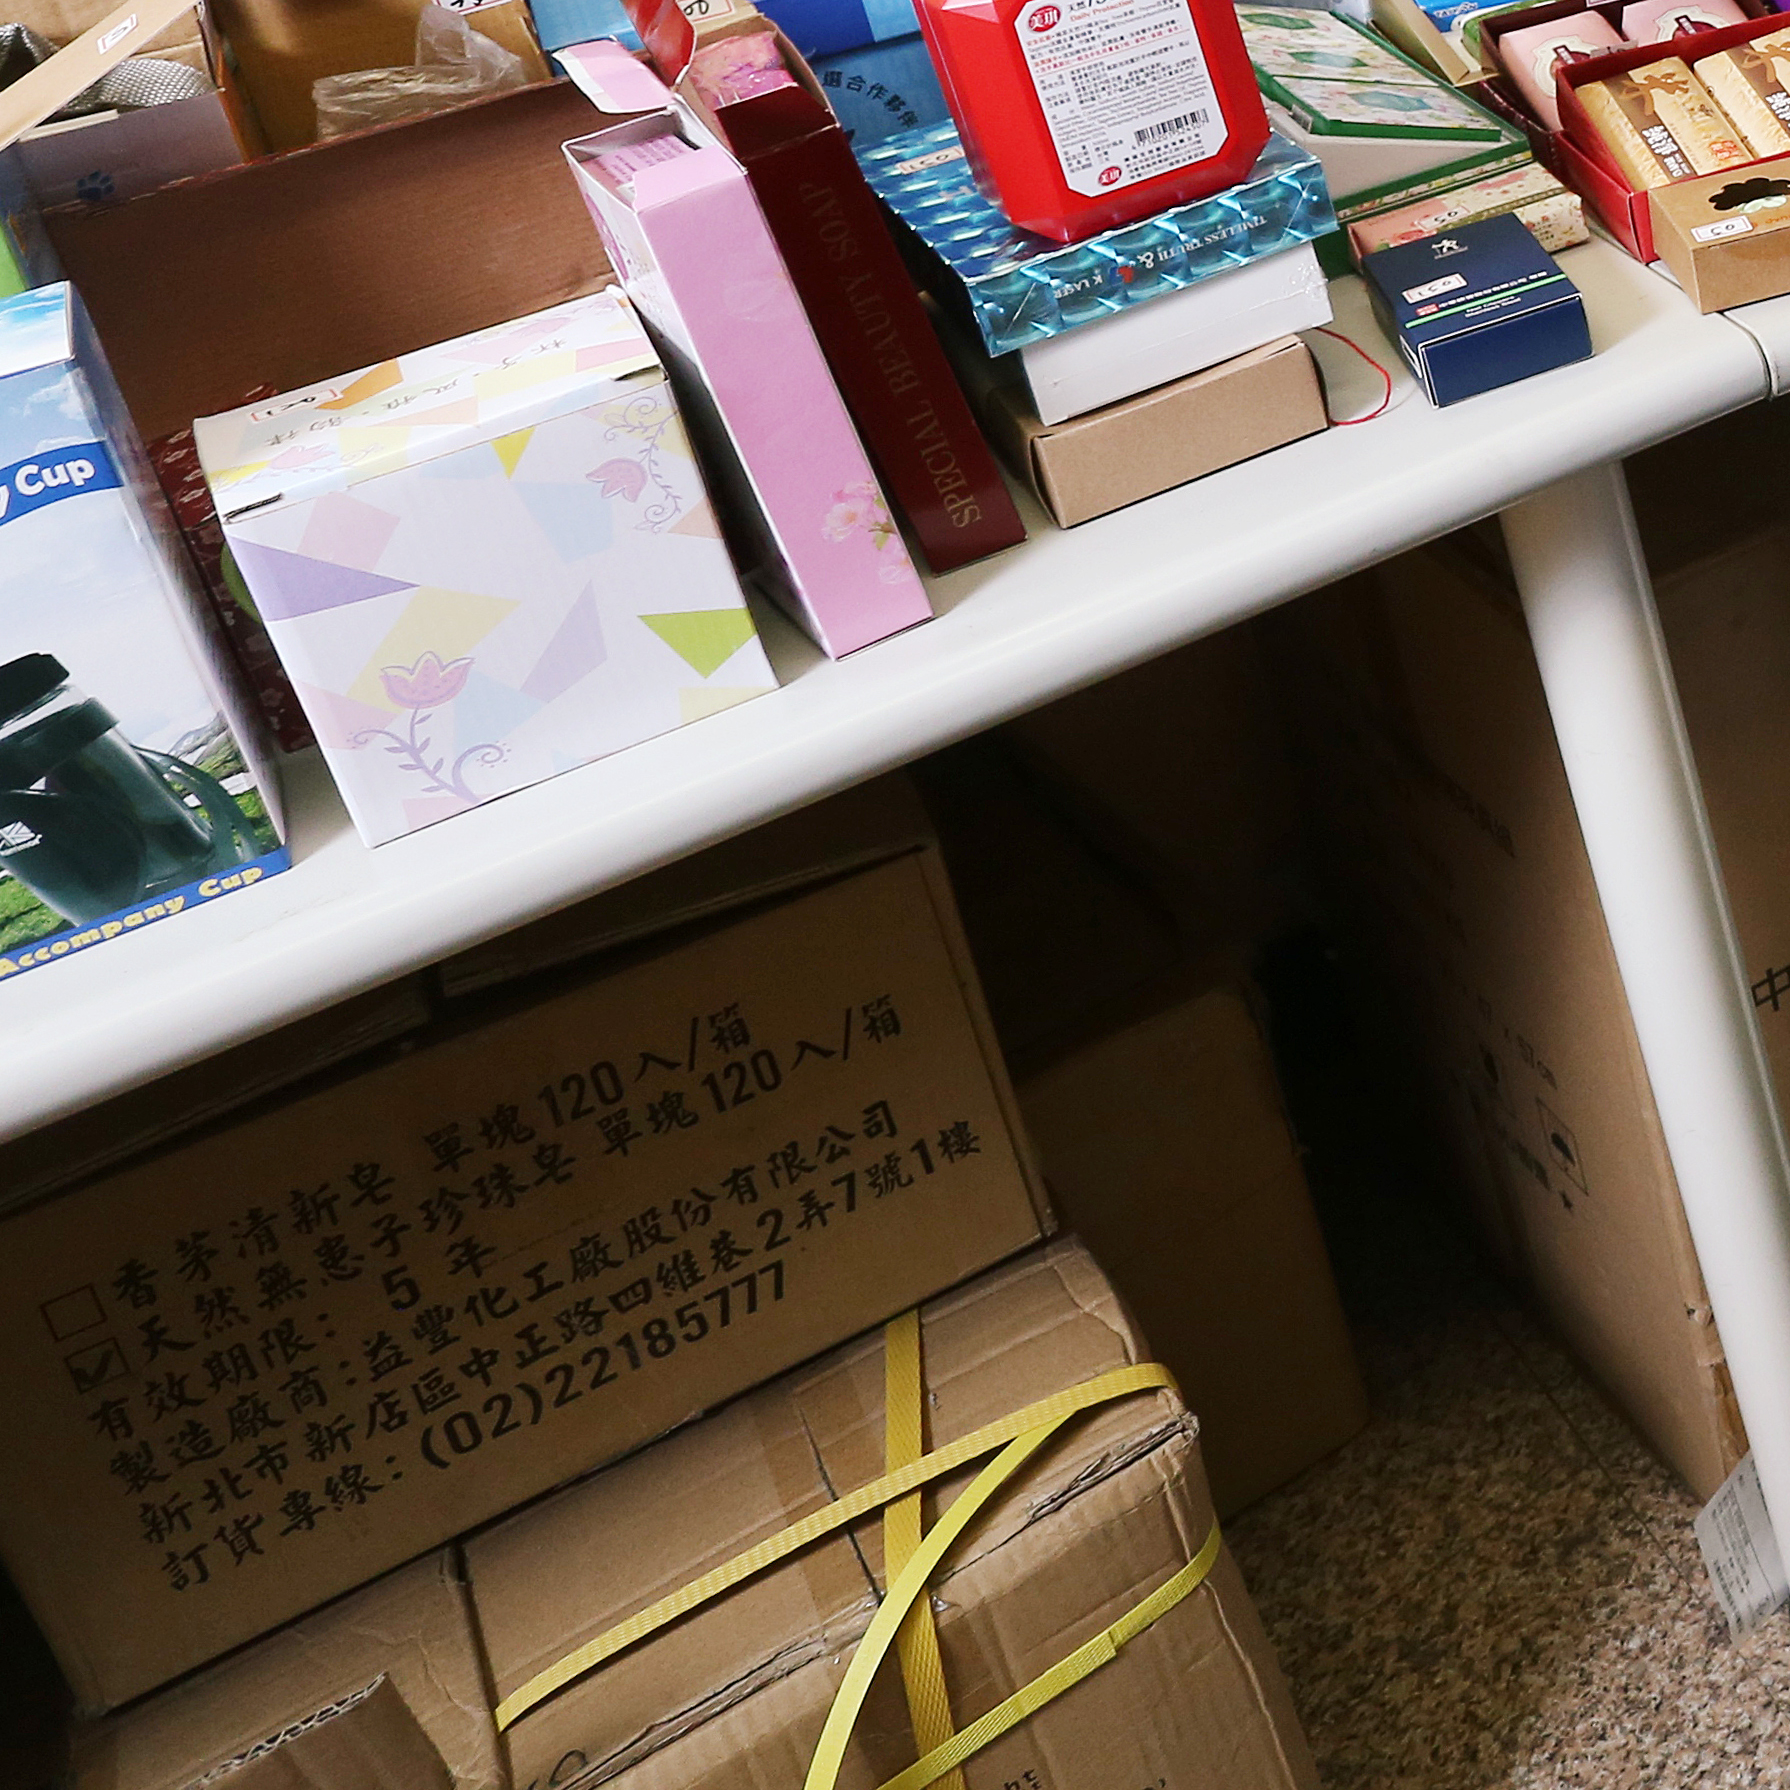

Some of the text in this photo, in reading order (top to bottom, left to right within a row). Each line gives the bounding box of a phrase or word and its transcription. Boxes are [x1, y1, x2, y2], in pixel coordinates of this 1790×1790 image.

[811, 70, 920, 128] 選合作夥伴
[850, 274, 922, 394] BEAUTY
[15, 453, 96, 499] Cup
[907, 401, 982, 528] SPECIAL
[0, 864, 263, 976] Accompany Cup
[112, 1001, 753, 1314] 香茅清新皂 單塊120入/箱
[137, 993, 903, 1364] 天然無患子珍珠皂 單塊120入/箱
[382, 1264, 420, 1313] 5
[445, 1235, 500, 1281] 年
